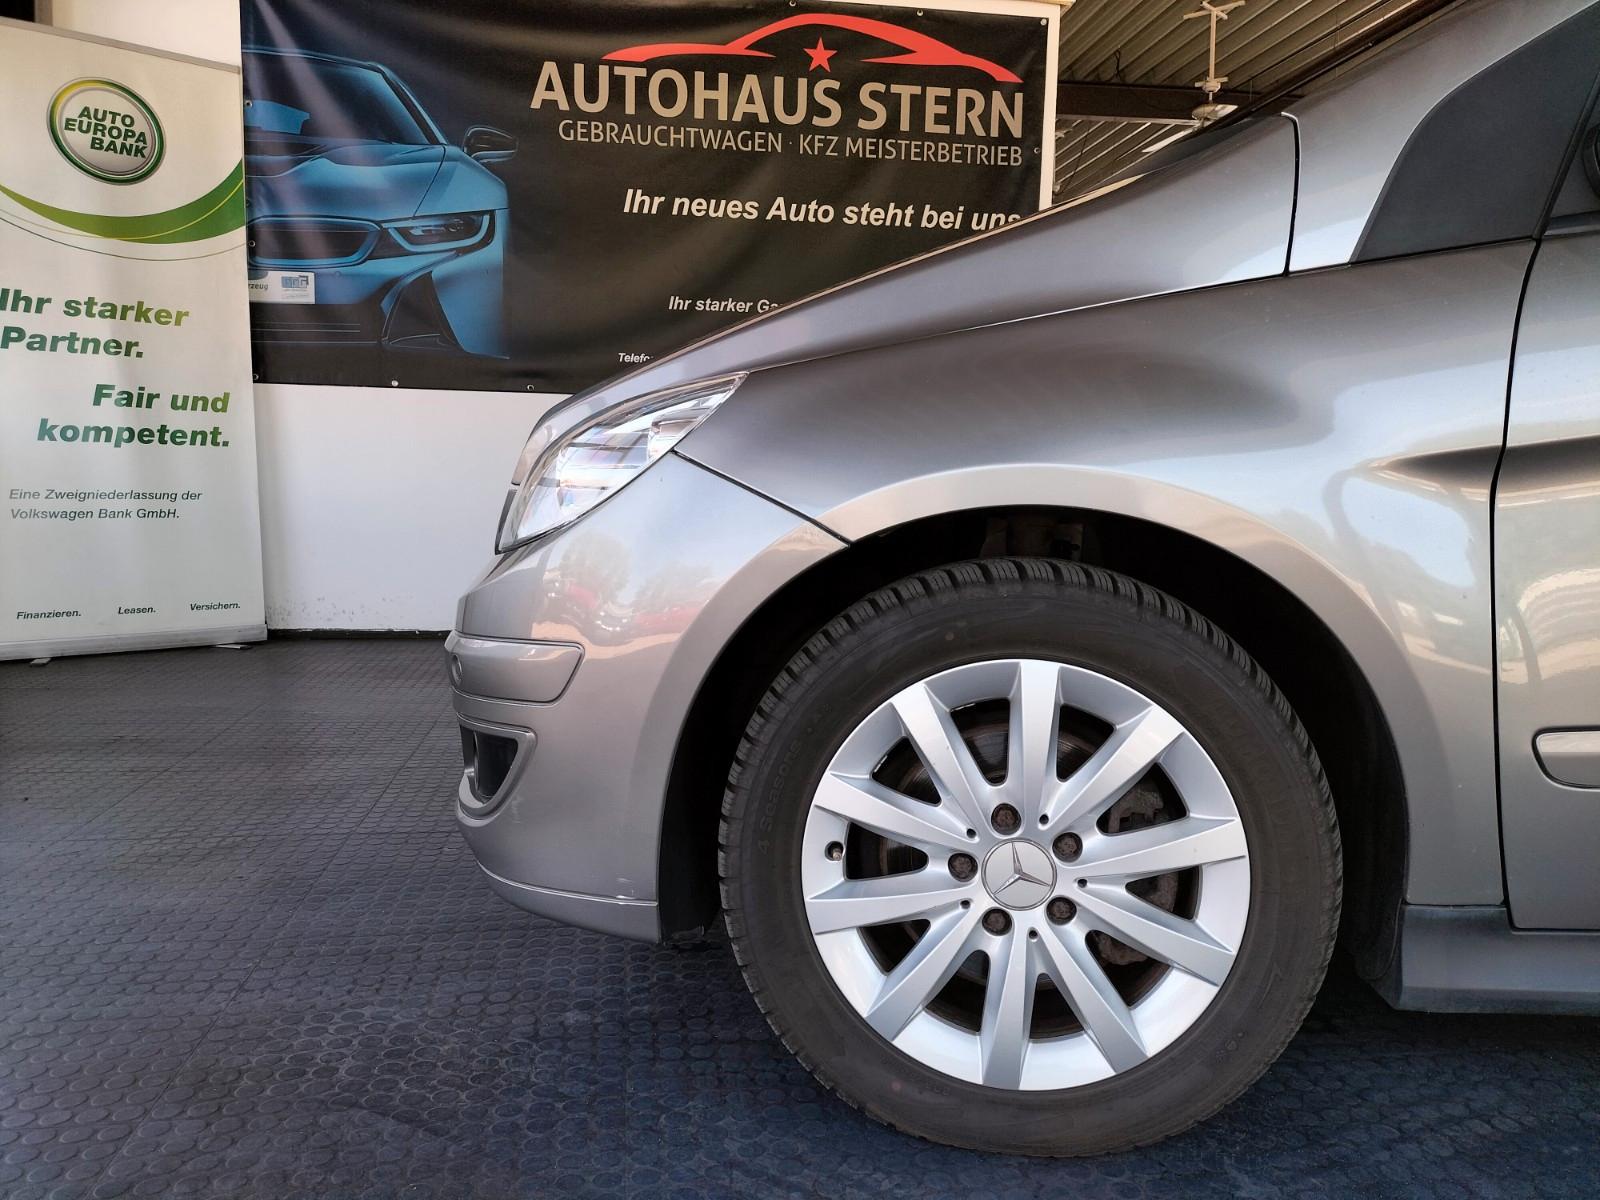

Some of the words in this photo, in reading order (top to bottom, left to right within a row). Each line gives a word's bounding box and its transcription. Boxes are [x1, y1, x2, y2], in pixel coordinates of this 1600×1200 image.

[530, 61, 842, 127] AUTOHAUS
[857, 82, 1024, 138] STERN
[78, 106, 135, 128] AUTO
[64, 118, 148, 145] EUROPA
[558, 119, 782, 152] GEBRAUCHTWAGEN
[800, 134, 840, 156] KFZ
[845, 137, 1023, 166] MEISTERBETRIEB
[90, 136, 148, 159] BANK
[623, 188, 665, 215] Ihr
[671, 196, 760, 220] neues
[766, 196, 835, 223] Auto
[843, 203, 913, 230] steht
[920, 204, 965, 229] bei
[0, 288, 52, 314] Ihr
[63, 297, 190, 326] starker
[668, 296, 691, 311] Ihr
[695, 298, 753, 313] starker
[0, 326, 143, 358] Partner.
[92, 384, 160, 409] Fair
[170, 392, 230, 413] und
[37, 418, 230, 448] kompetent.
[9, 489, 40, 500] Eine
[45, 489, 178, 502] Zweigniederlassung
[181, 490, 202, 501] der
[10, 508, 94, 521] Volkswagen
[98, 508, 132, 519] Bank
[136, 508, 180, 519] GmbH.
[16, 608, 82, 620] Finanzieren.
[118, 606, 156, 615] Leasen.
[190, 601, 241, 612] Versichern.
